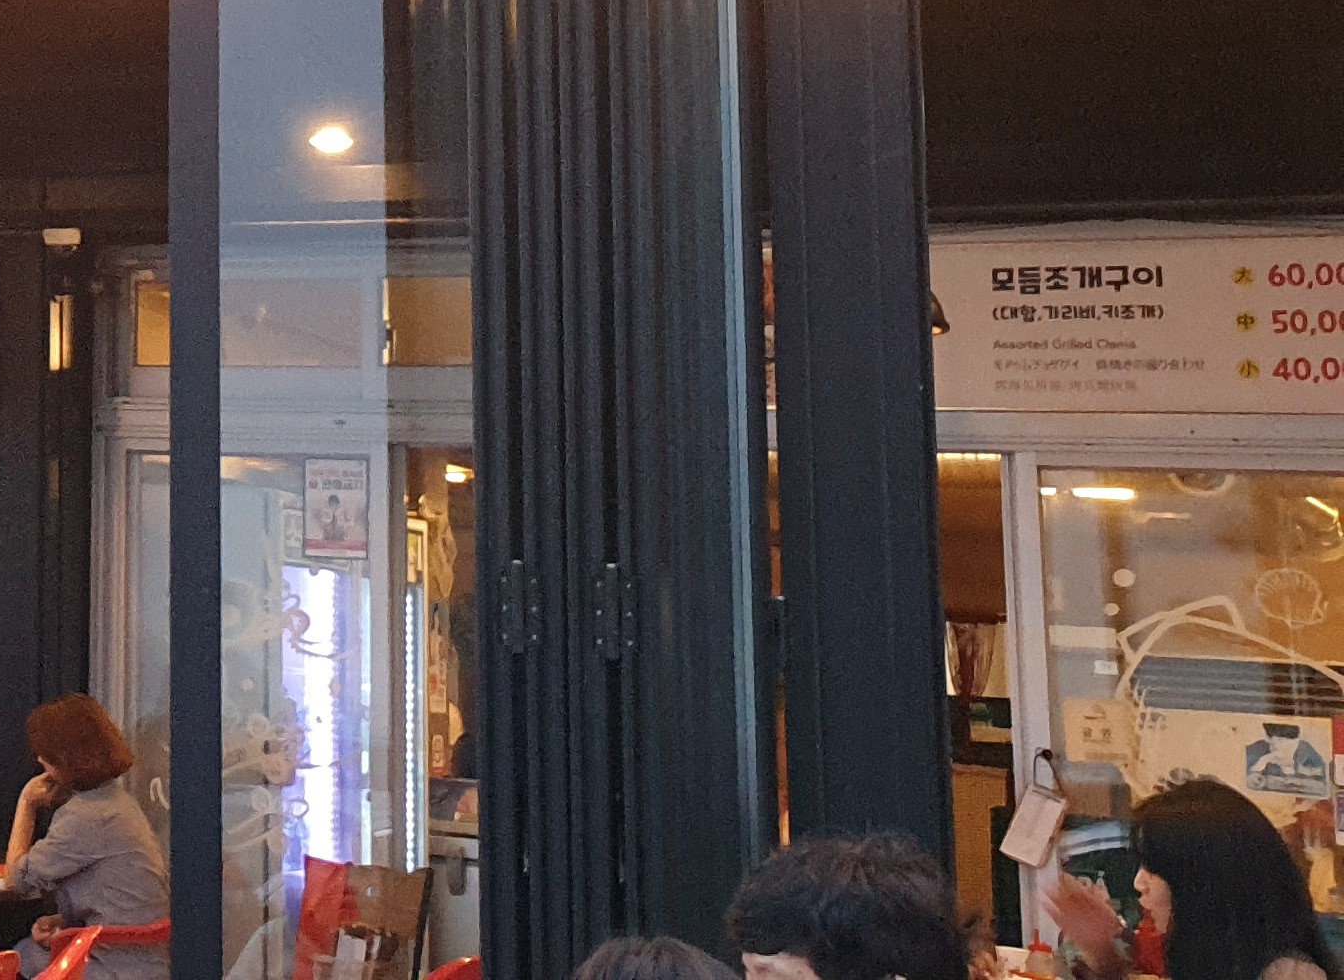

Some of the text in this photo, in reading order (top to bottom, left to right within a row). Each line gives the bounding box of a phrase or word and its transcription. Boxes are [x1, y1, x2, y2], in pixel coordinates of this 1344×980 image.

[991, 265, 1164, 294] 모듬조개구이
[1271, 308, 1344, 337] 50,0
[1271, 356, 1344, 384] 40,0
